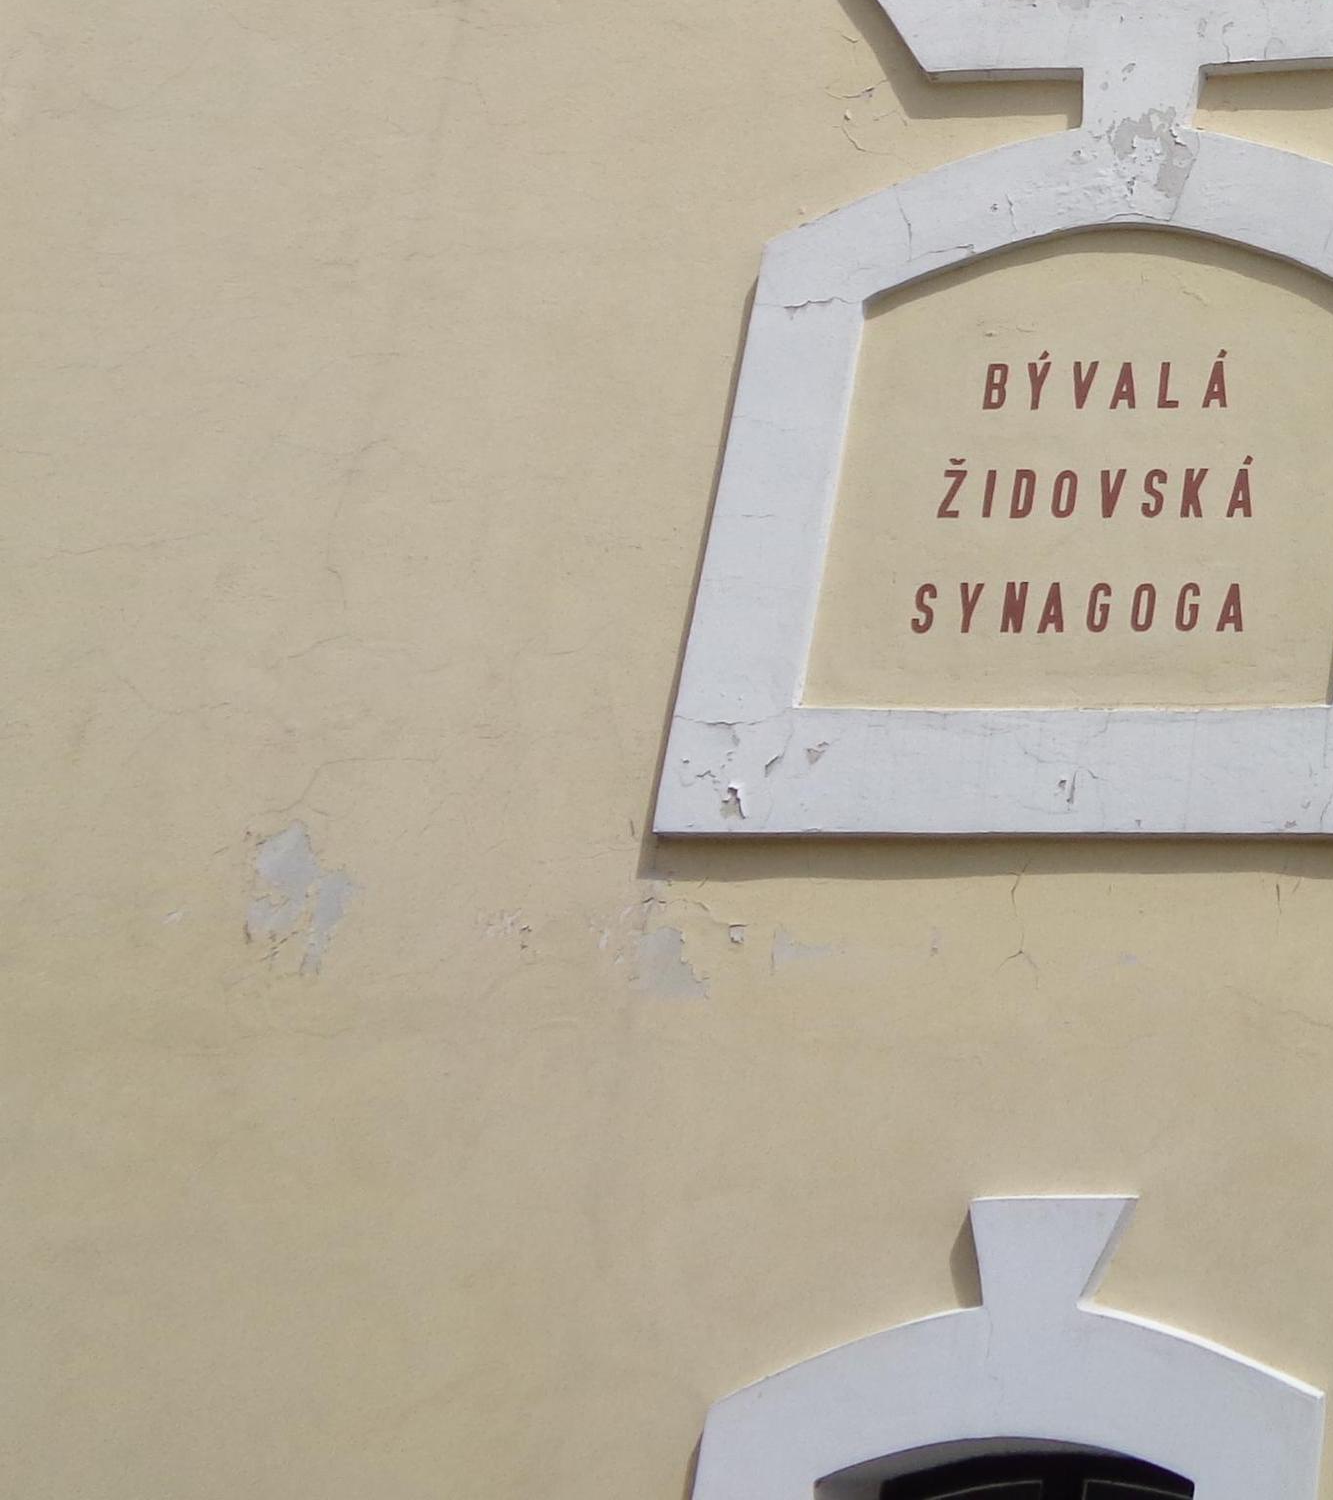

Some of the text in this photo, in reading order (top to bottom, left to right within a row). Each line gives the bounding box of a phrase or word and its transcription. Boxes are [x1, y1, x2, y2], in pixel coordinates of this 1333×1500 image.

[982, 349, 1229, 410] BÝVALÁ
[936, 455, 1253, 518] ŽIDOVSKÁ
[910, 582, 1243, 634] SYNAGOGA
